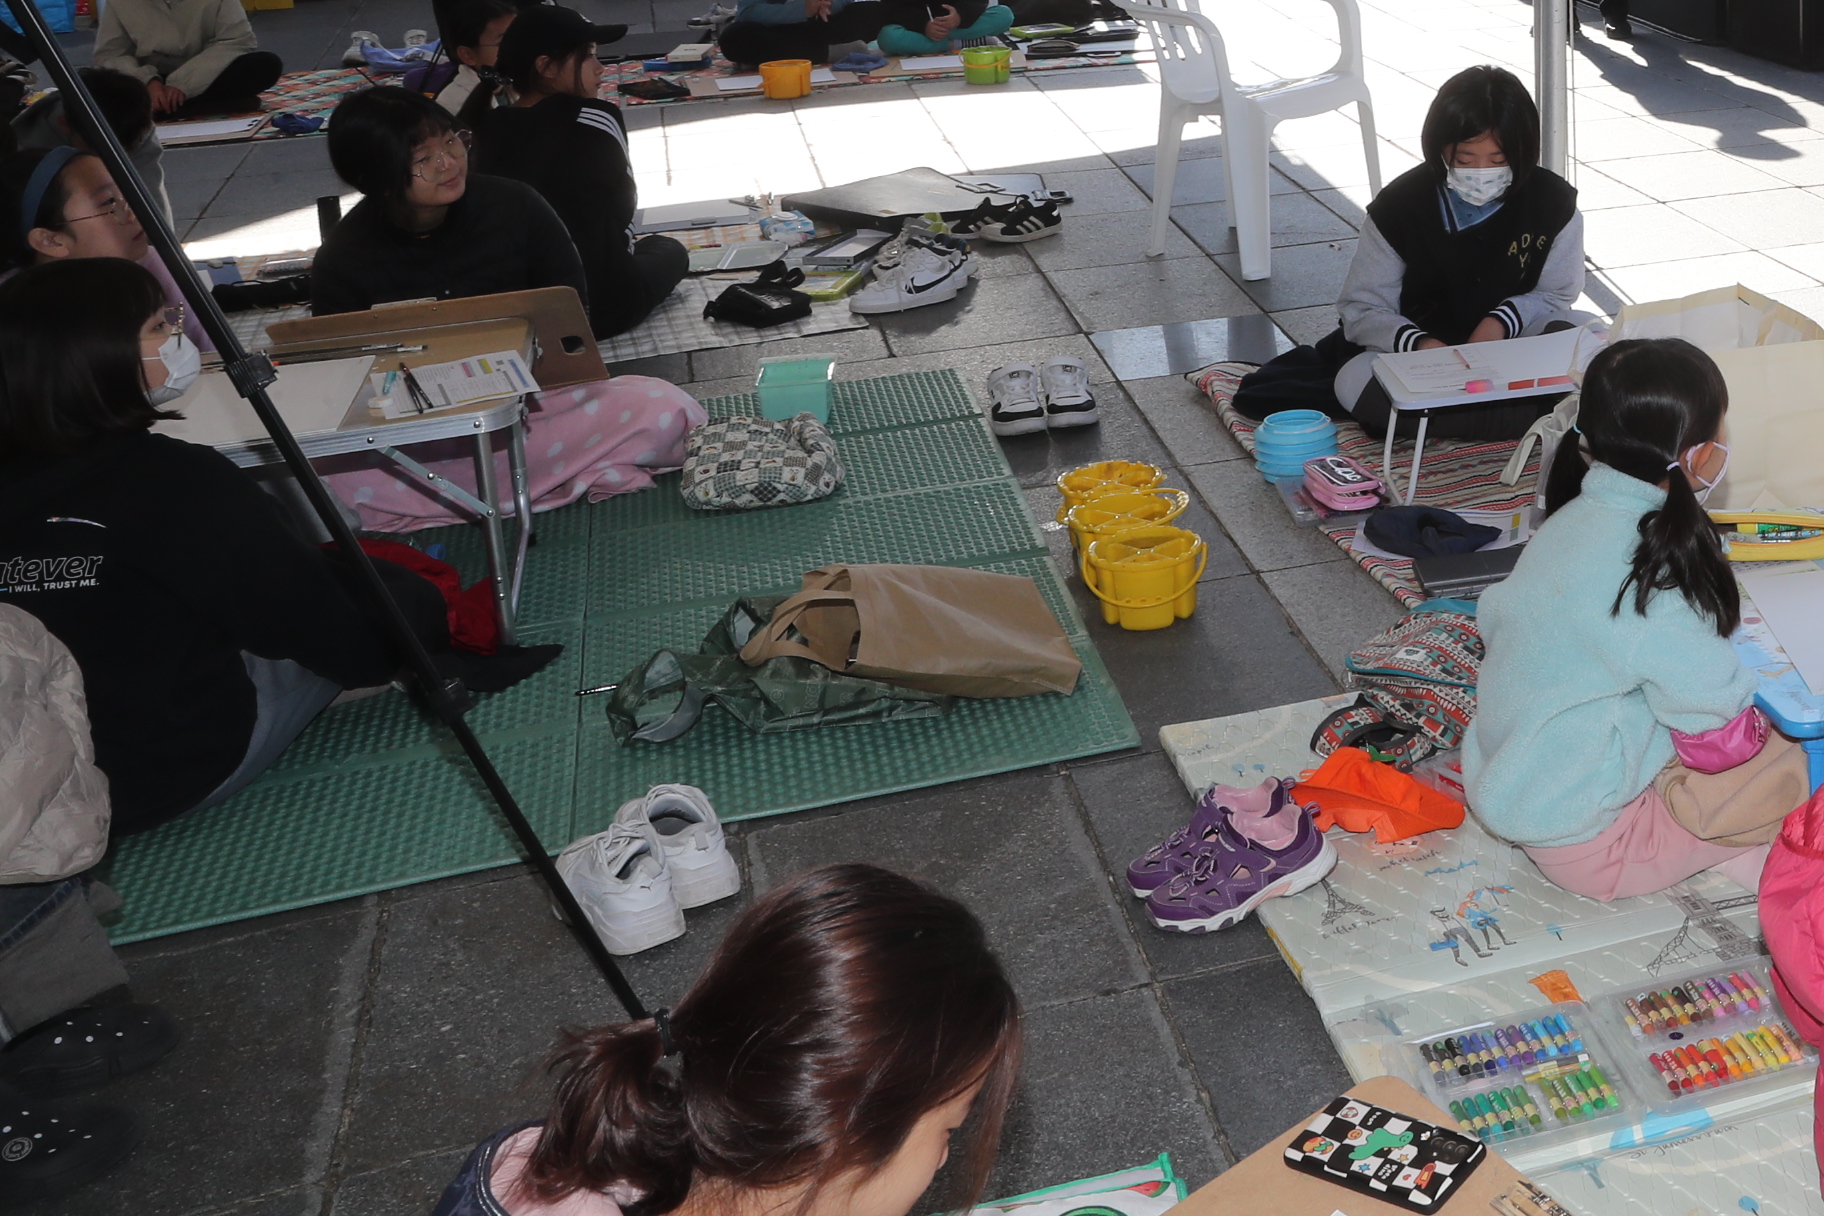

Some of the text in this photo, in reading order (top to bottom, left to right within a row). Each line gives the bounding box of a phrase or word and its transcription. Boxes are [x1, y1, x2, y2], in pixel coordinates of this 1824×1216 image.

[14, 584, 41, 593] WILL,
[43, 580, 78, 590] TRUST
[79, 578, 100, 587] ME.
